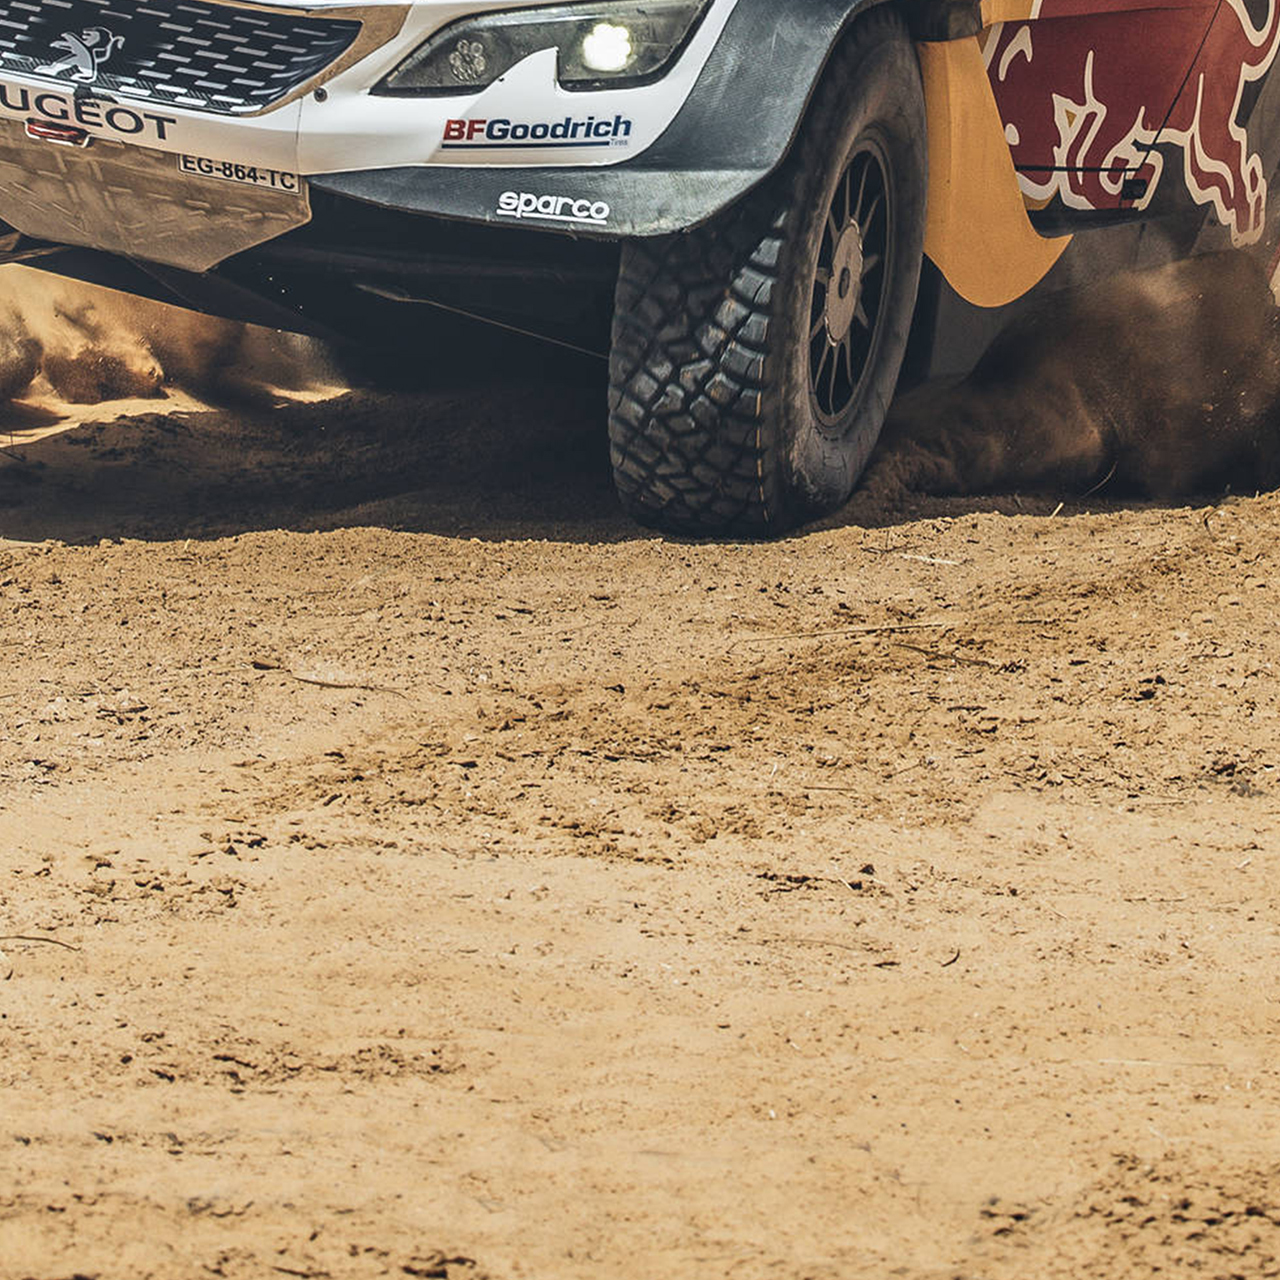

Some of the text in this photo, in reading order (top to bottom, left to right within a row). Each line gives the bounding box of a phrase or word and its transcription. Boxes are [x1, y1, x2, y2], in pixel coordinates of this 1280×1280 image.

[443, 115, 633, 141] BFGoodrich
[182, 153, 296, 191] EG-864-TC
[498, 191, 610, 219] sparco
